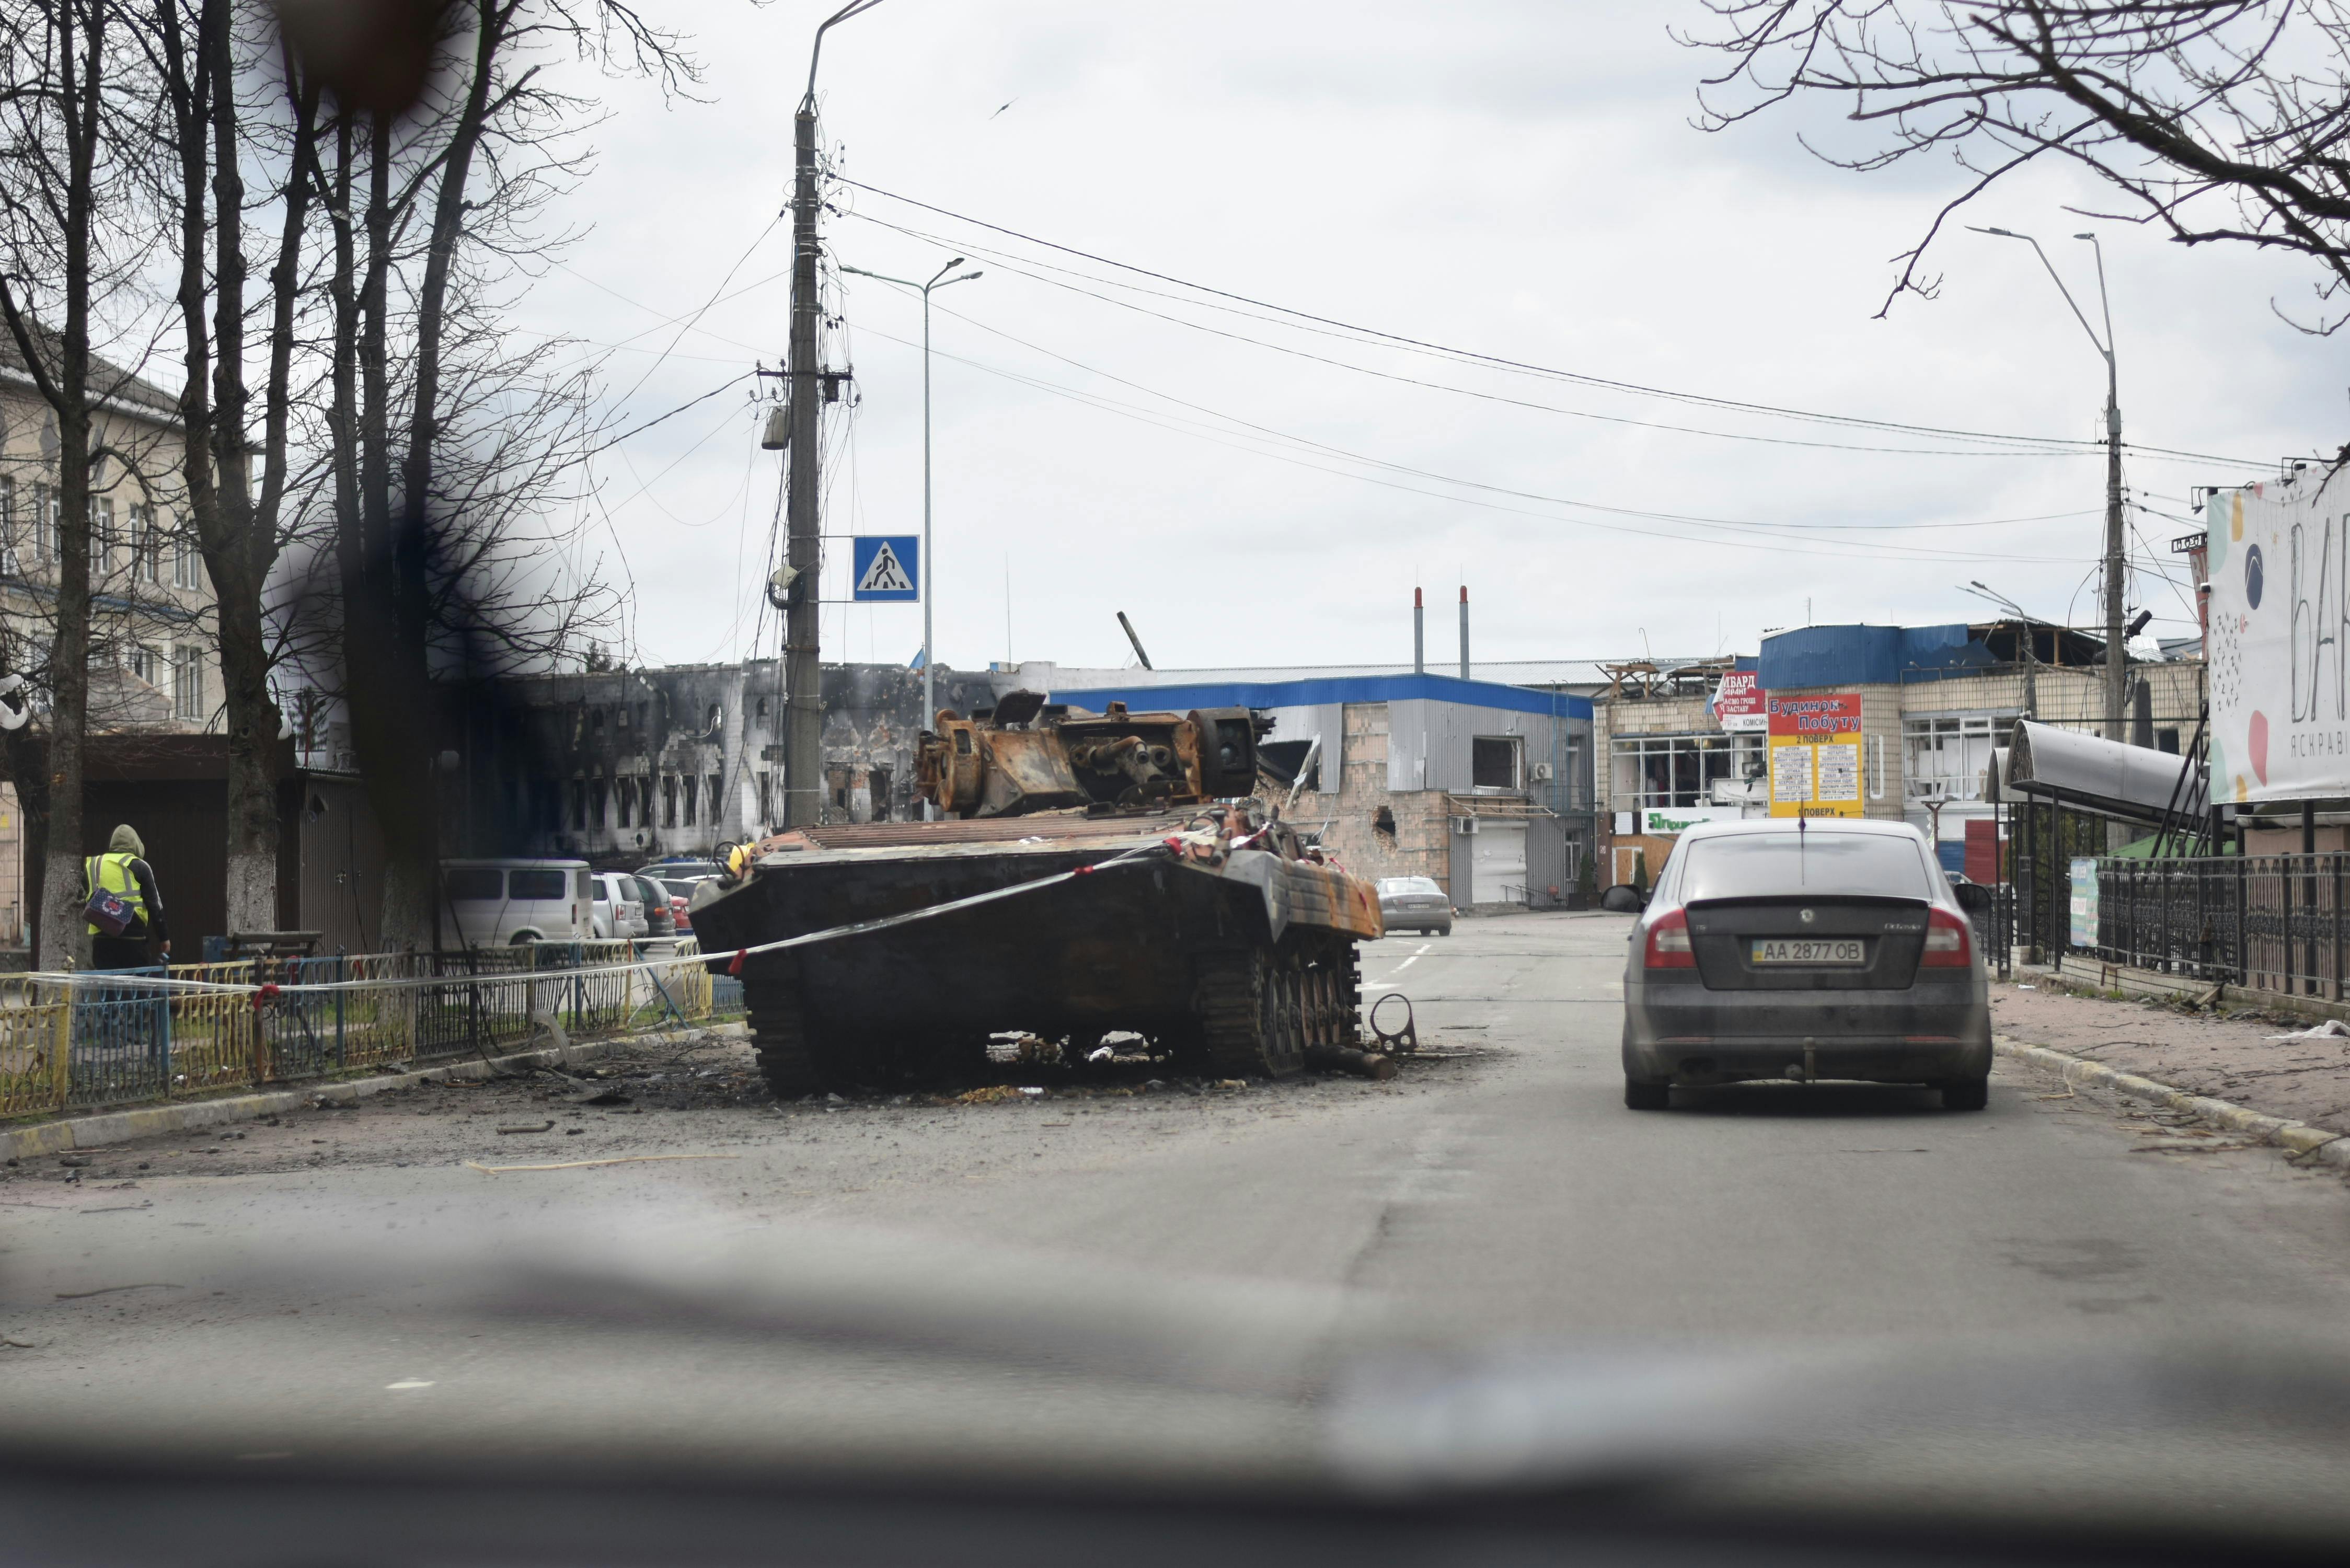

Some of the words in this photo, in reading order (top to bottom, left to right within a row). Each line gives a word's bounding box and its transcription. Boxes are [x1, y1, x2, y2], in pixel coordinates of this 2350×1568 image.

[1769, 699, 1840, 717] Будинок
[1799, 714, 1860, 732] Побуту
[1796, 735, 1801, 744] 2
[1803, 734, 1834, 743] ПОВЕРХ
[2291, 731, 2348, 758] ЯСКРАВІ
[1804, 808, 1835, 816] ПОВЕРХ
[1764, 943, 1788, 959] AA
[1792, 943, 1831, 959] 2877
[1835, 943, 1860, 959] OB
